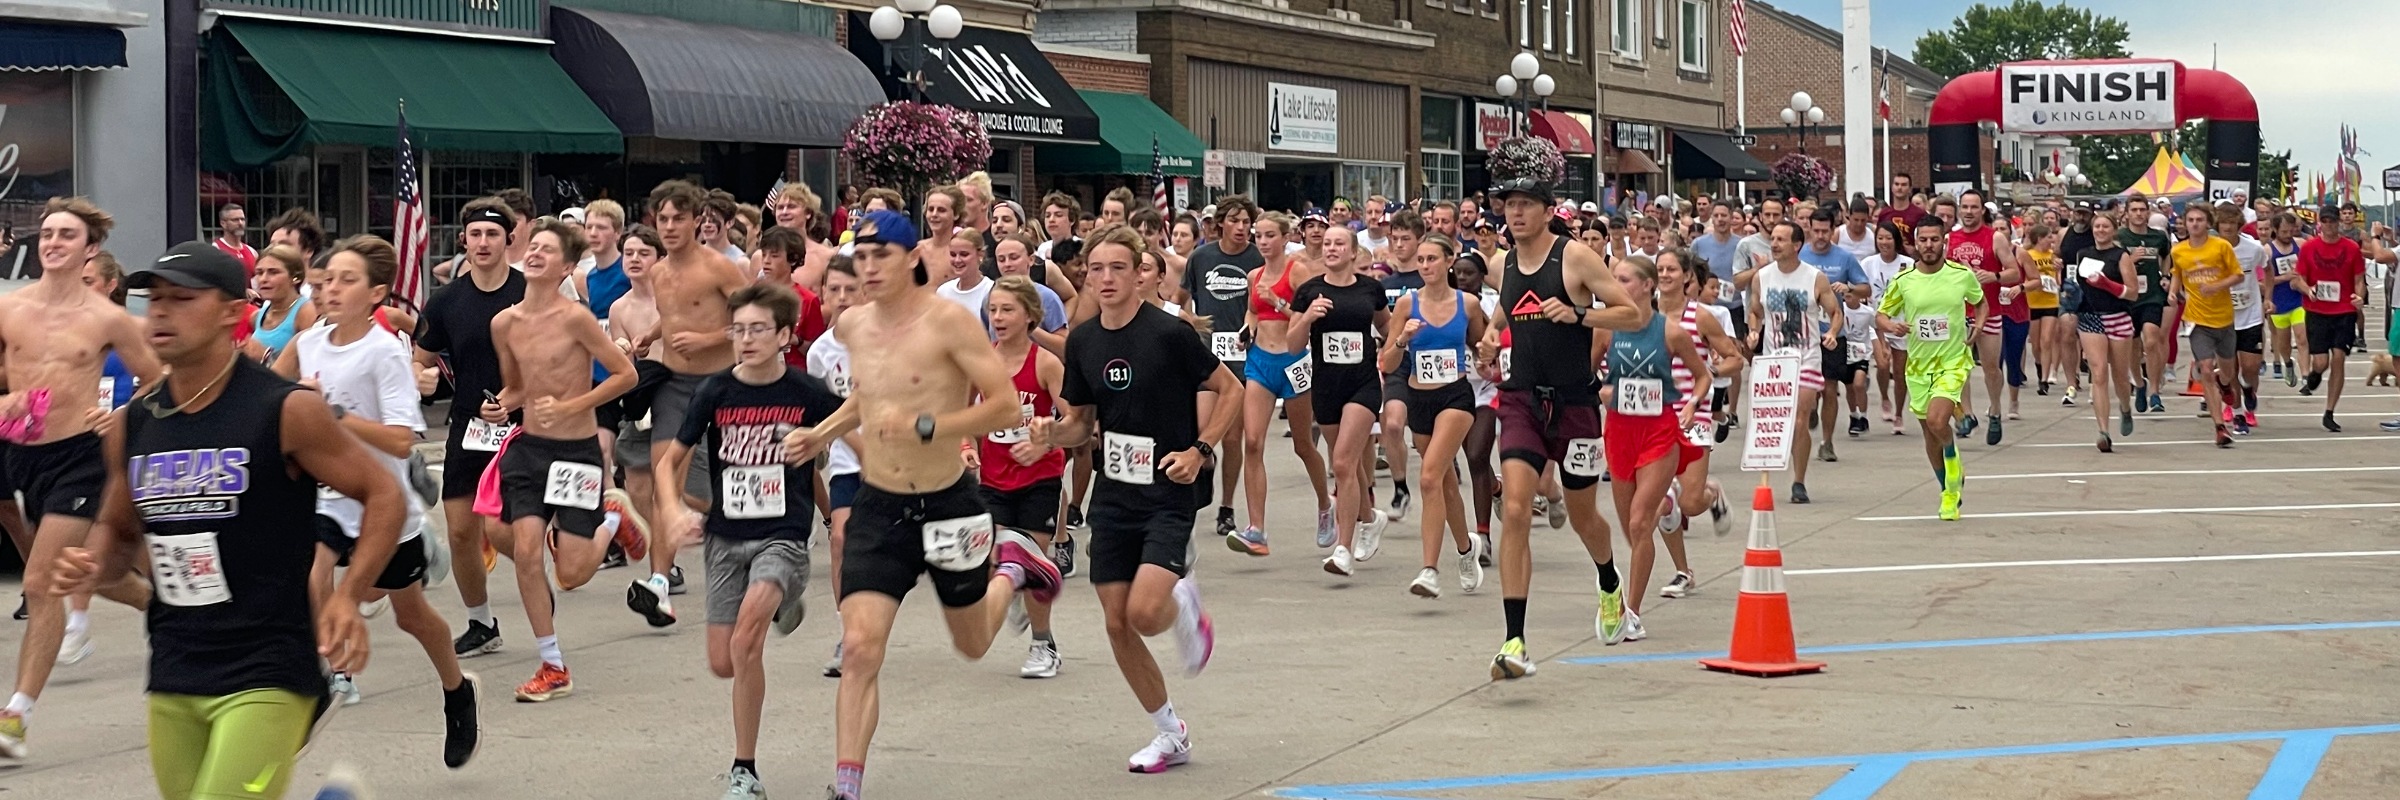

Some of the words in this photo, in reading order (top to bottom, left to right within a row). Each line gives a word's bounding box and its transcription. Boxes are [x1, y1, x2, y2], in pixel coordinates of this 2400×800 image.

[2009, 71, 2167, 104] FINISH
[1283, 92, 1302, 119] Lake
[1303, 94, 1336, 122] Lifestyle
[2051, 109, 2145, 122] KINGLAND
[1014, 116, 1040, 134] COCKTAIL
[1041, 118, 1063, 135] LOUNGE
[1744, 136, 1753, 145] St
[1919, 318, 1930, 338] 278
[1937, 321, 1948, 331] 5K
[1216, 336, 1226, 357] 225
[1328, 336, 1339, 359] 197
[1349, 341, 1361, 351] 5K
[1614, 341, 1632, 349] CLEAR
[1632, 348, 1641, 360] A
[1421, 354, 1433, 380] 251
[1442, 360, 1456, 370] 5K
[1768, 364, 1781, 379] NO
[1108, 367, 1128, 382] 13.1
[1291, 366, 1308, 389] 600
[1624, 383, 1636, 410] 249
[1648, 390, 1660, 401] 5K
[1753, 381, 1793, 398] PARKING
[1752, 406, 1793, 419] TEMPORARY
[468, 427, 483, 439] 5K
[1756, 421, 1785, 434] POLICE
[1754, 436, 1781, 448] ORDER
[1109, 438, 1122, 474] 007
[1133, 452, 1150, 466] 5K
[1571, 443, 1588, 470] 191
[731, 470, 747, 513] 456
[763, 479, 782, 496] 5K
